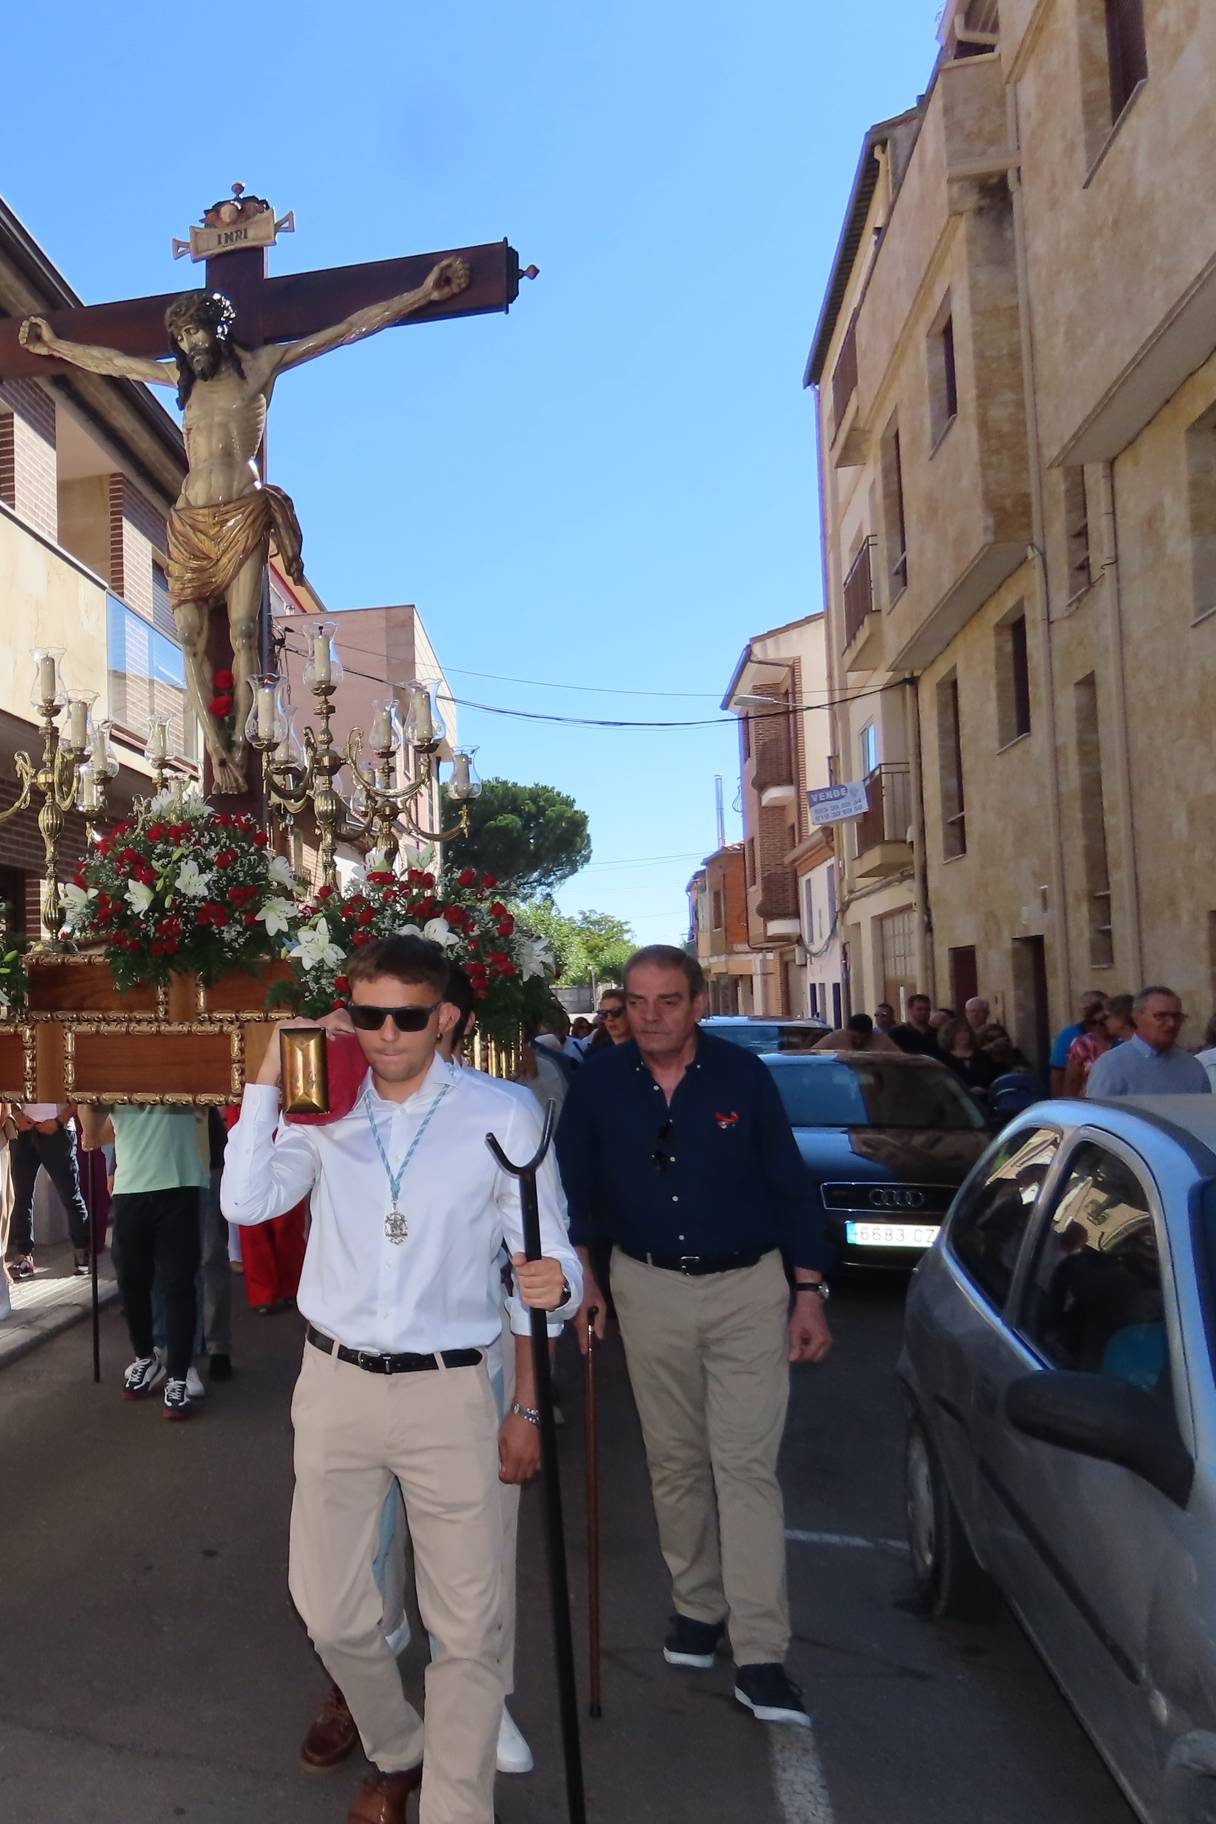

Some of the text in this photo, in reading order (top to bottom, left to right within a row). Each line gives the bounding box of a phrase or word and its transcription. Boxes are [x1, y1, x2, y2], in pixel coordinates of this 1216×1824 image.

[217, 228, 248, 245] INRI
[810, 787, 848, 802] VENDE
[860, 1226, 905, 1242] 6683
